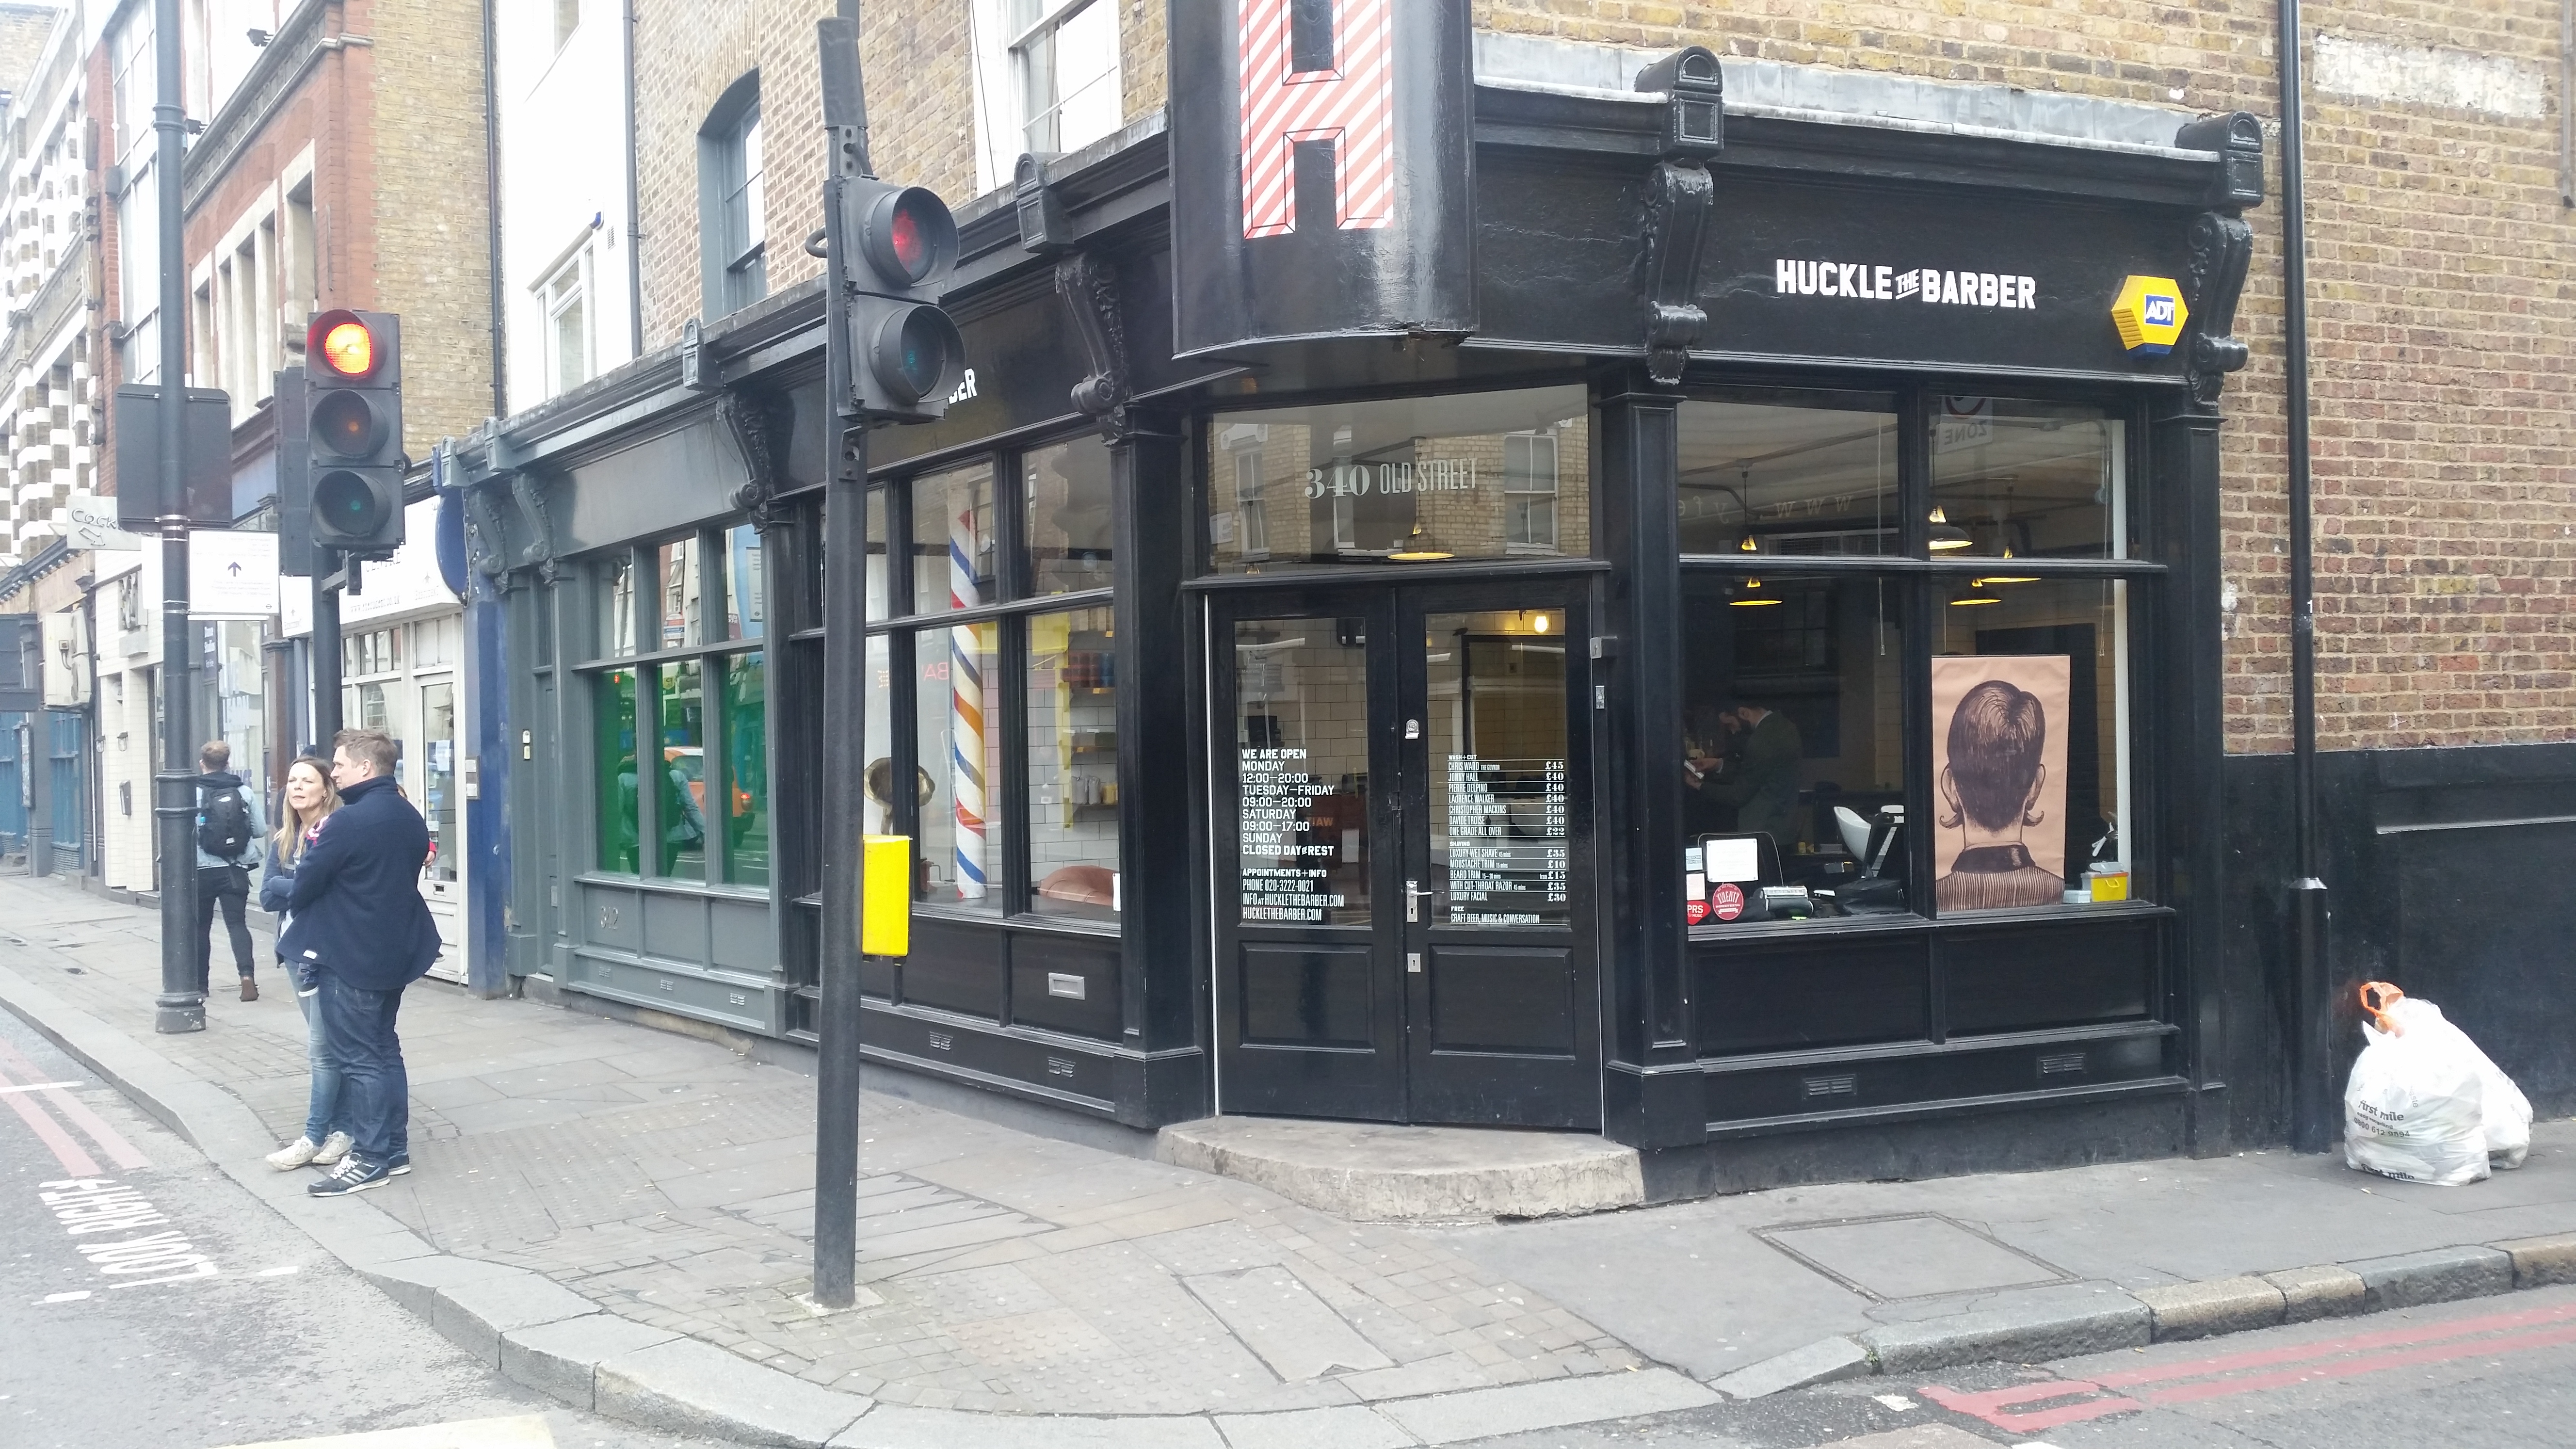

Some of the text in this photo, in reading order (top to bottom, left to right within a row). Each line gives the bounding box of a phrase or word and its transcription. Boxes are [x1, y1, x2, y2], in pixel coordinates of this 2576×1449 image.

[1776, 259, 2036, 309] HUCKLE THE BARBER
[2145, 301, 2174, 321] ADT
[949, 368, 978, 404] ER
[1304, 457, 1478, 499] 340 OLD STREET
[1242, 749, 1306, 759] WE ARE OPEN
[1242, 761, 1285, 771] MONDAY
[1448, 762, 1463, 771] CHRIS
[1464, 762, 1479, 771] WARD
[1545, 761, 1563, 770] £45
[1449, 772, 1564, 782] JONNY HALL £40
[1449, 783, 1564, 792] PIERRE DELPINO £40
[1474, 794, 1494, 803] WALKER
[1546, 794, 1564, 803] £40
[1242, 809, 1296, 819] SATURDAY
[1449, 805, 1564, 814] CHRISTOPHER MACKINS £40
[1449, 816, 1564, 825] DAVIDE TROISE £40
[1449, 827, 1565, 836] ONE GRADE ALL OVER £22
[1242, 833, 1283, 843] SUNDAY
[1242, 845, 1334, 856] CLOSED DAY OF REST
[1449, 849, 1469, 857] LUXURY
[1469, 849, 1481, 857] WET
[1481, 849, 1497, 857] SHAVE
[1547, 849, 1565, 858] £35
[1450, 859, 1480, 869] MOUSTACHE
[1481, 859, 1495, 868] TRIM
[1547, 860, 1565, 869] £10
[1450, 870, 1466, 879] BEARD
[1467, 870, 1481, 879] TRIM
[1547, 871, 1566, 880] £15
[1242, 879, 1313, 892] PHONE 020-3222-0021
[1450, 881, 1464, 890] WITH
[1464, 881, 1494, 890] CUT-THROAT
[1495, 881, 1512, 890] RAZOR
[1547, 882, 1566, 891] £35
[1243, 893, 1257, 905] INFO
[1265, 893, 1344, 907] HUCKLETHEBARBER.COM
[1450, 892, 1566, 902] LUXURY FACIAL £30
[1243, 907, 1322, 921] HUCKLETHEBARBER.COM
[1687, 905, 1704, 914] PRS
[1451, 913, 1540, 924] CRAFT BEER, MUSIC & CONVERSATION
[2358, 1100, 2404, 1121] first mile
[2354, 1117, 2369, 1130] 0800
[2372, 1127, 2385, 1136] 612
[39, 1185, 219, 1289] LOOK RIGHT
